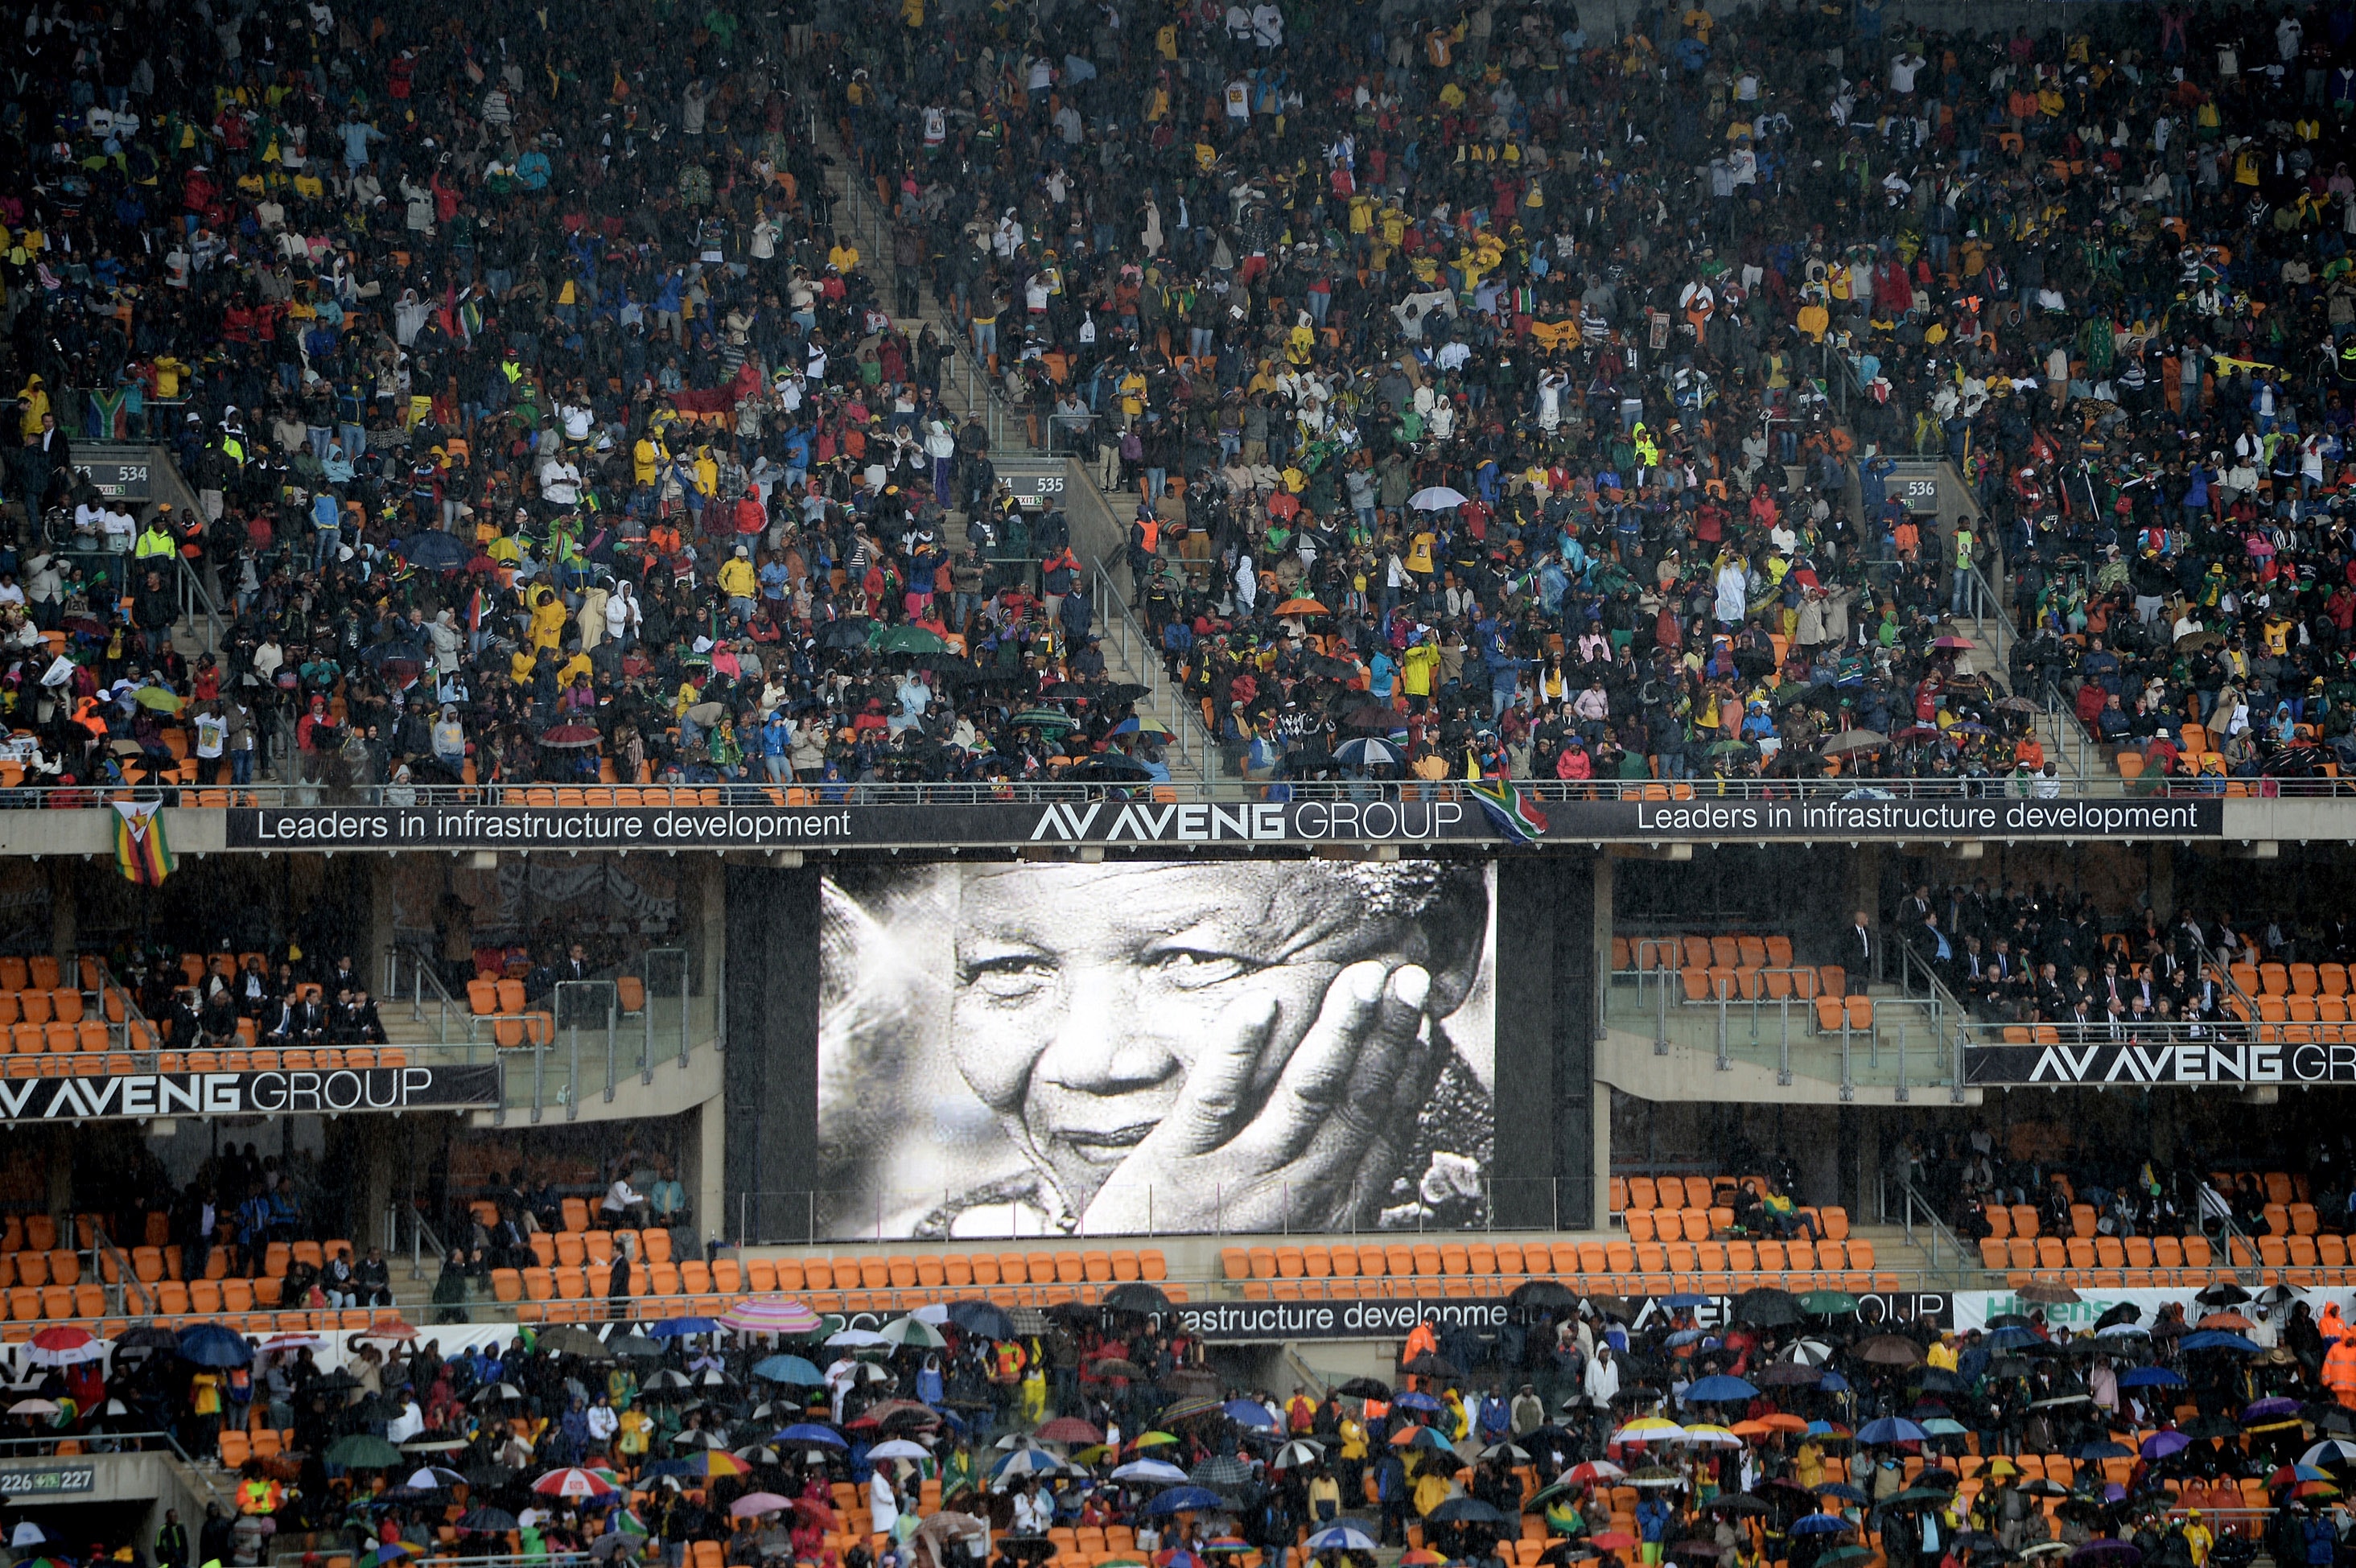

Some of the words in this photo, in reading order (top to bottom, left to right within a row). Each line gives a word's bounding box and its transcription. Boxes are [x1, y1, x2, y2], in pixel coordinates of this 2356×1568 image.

[119, 466, 147, 481] 534
[1037, 477, 1064, 492] 535
[1909, 481, 1934, 496] 536
[258, 810, 388, 838] Leaders
[400, 809, 425, 838] in
[438, 809, 643, 838] infrastructure
[653, 809, 851, 843] development
[1106, 803, 1286, 841] AVENG
[1295, 801, 1463, 840] GROUP
[1637, 803, 1757, 829] Leaders
[1768, 801, 1791, 829] in
[1803, 801, 1996, 829] infrastructure
[2006, 801, 2197, 833] development
[2104, 1045, 2284, 1082] AVENG
[43, 1073, 241, 1117] AVENG
[251, 1068, 432, 1111] GROUP
[1, 1474, 33, 1492] 226
[61, 1470, 93, 1488] 227
